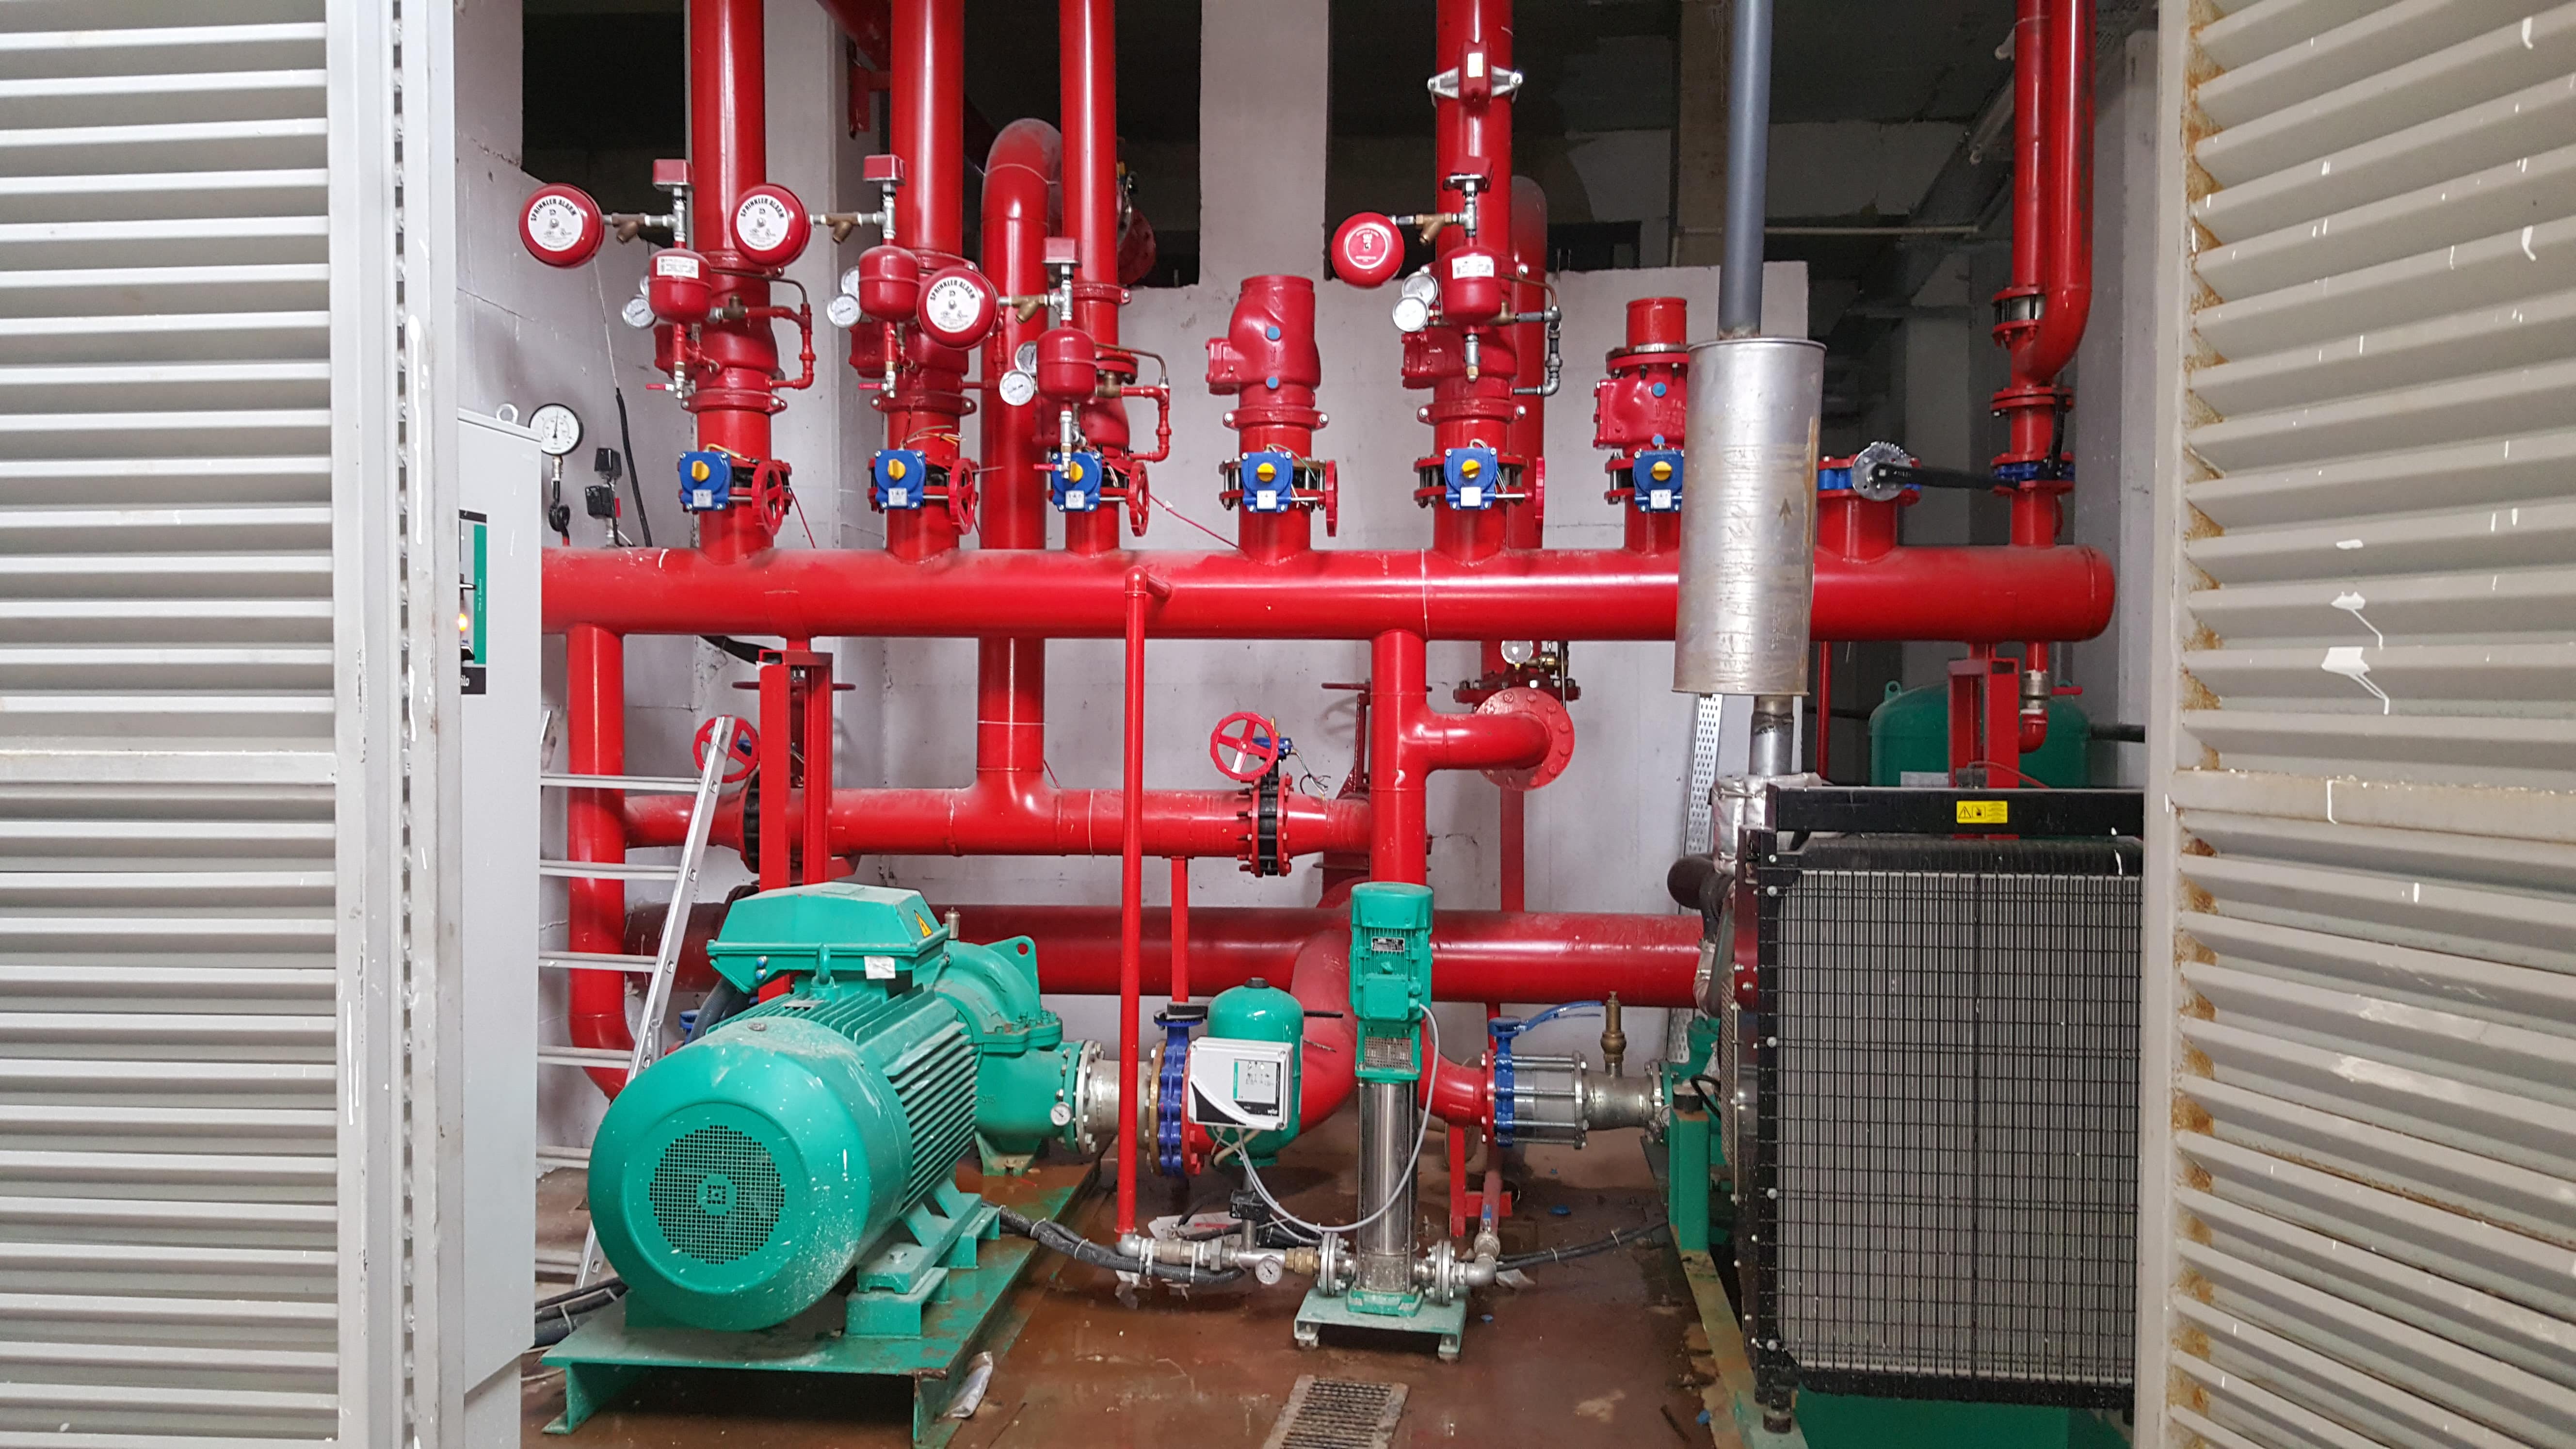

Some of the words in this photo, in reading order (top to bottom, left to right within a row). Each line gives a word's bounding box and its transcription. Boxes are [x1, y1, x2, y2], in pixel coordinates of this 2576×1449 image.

[531, 198, 557, 221] SPRINKLER
[558, 199, 577, 216] ALARM
[741, 198, 768, 217] SPRINKLER
[769, 200, 785, 218] ALARM
[930, 279, 957, 301] SPRINKLER
[959, 281, 976, 299] ALARM
[460, 675, 469, 687] ilo
